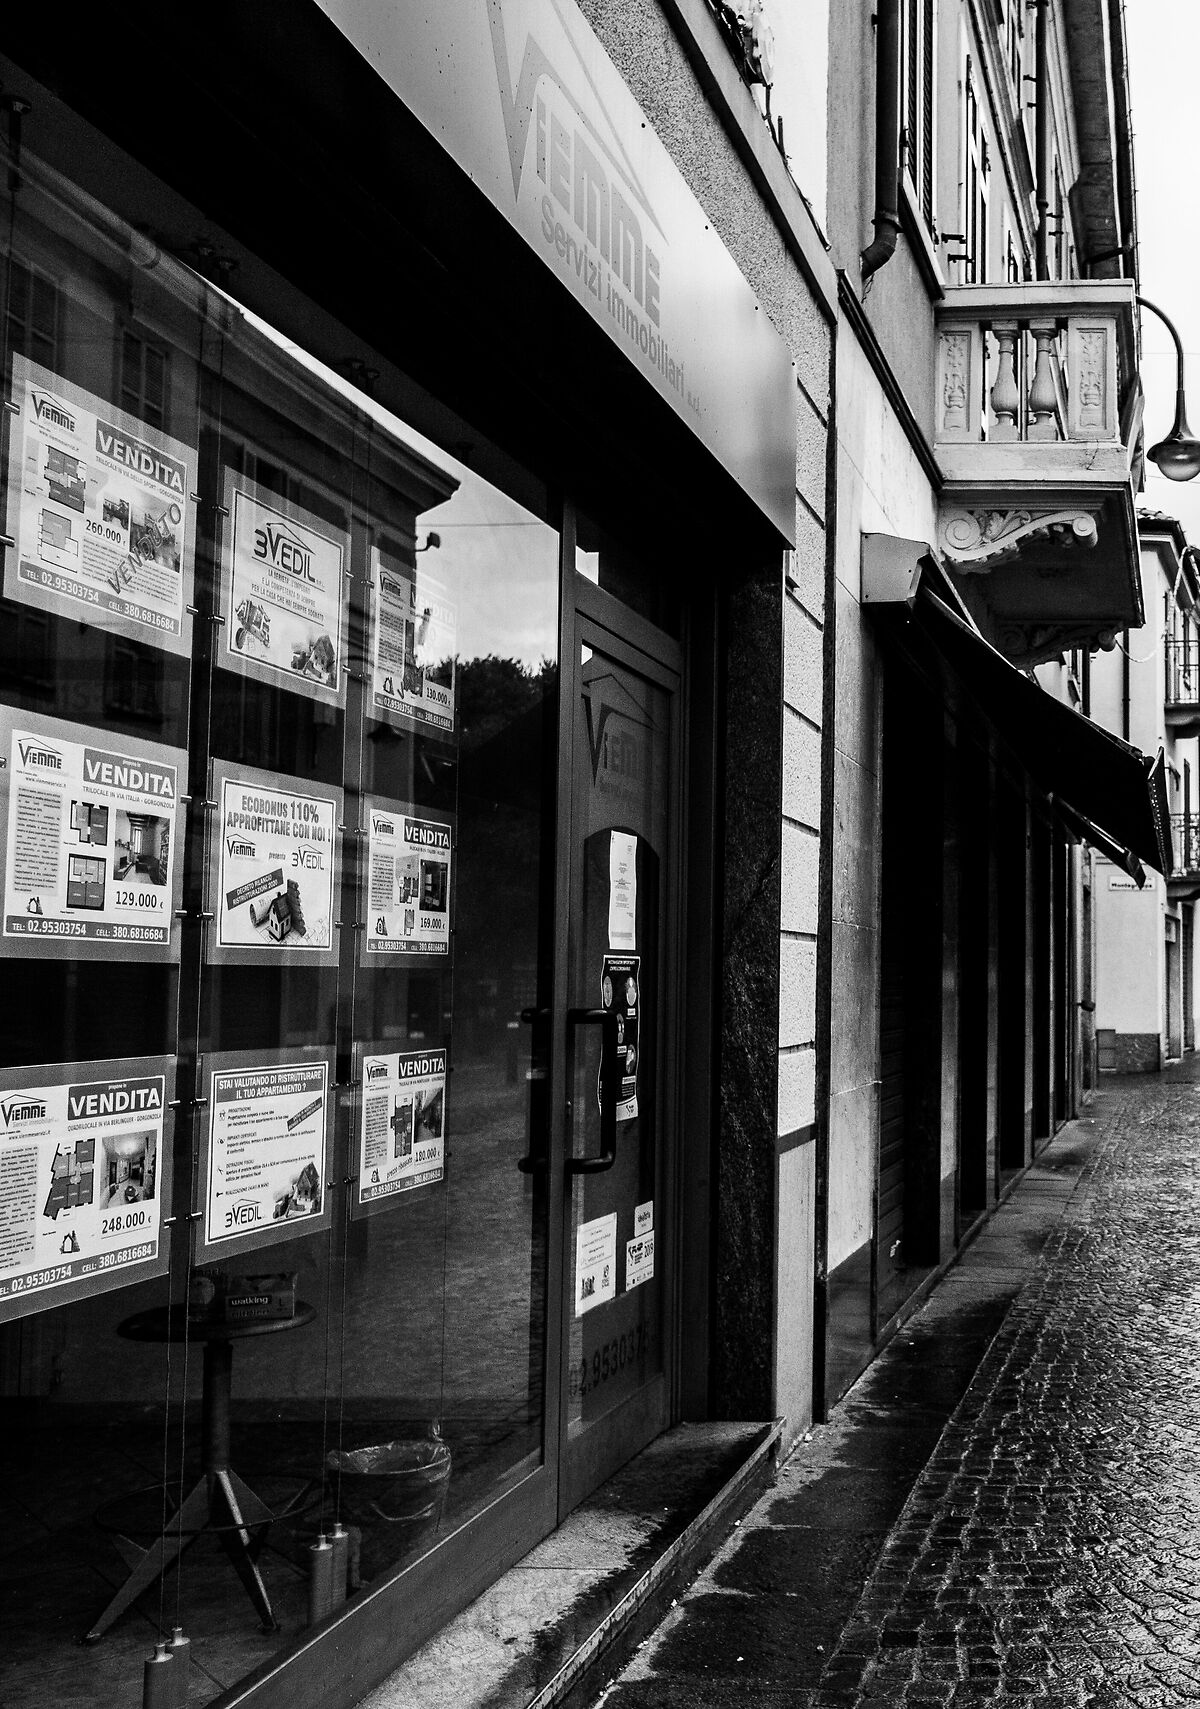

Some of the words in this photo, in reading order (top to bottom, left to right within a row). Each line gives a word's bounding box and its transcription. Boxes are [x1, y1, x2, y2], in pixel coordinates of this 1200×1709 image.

[541, 195, 602, 302] Servizi
[97, 429, 184, 494] VENDITA
[85, 519, 122, 544] 260.000
[107, 502, 182, 596] VENDUTO
[26, 569, 40, 581] TEL:
[41, 571, 99, 604] 02.95303754
[108, 601, 123, 613] CELL:
[124, 602, 175, 632] 380.6816684
[426, 687, 448, 705] 130.000
[85, 758, 174, 797] VENDITA
[82, 785, 109, 797] TRILOCALE
[109, 790, 116, 798] IN
[116, 791, 125, 800] VIA
[125, 794, 140, 803] ITALIA
[143, 798, 175, 809] GORGONZOLA
[241, 795, 288, 819] ECOBONUS
[290, 800, 320, 824] 110%
[226, 811, 291, 837] APPROFITTANE
[292, 822, 310, 840] CON
[311, 825, 326, 843] NOI
[405, 825, 449, 848] VENDITA
[115, 890, 157, 909] 129.000
[12, 922, 26, 932] TEL:
[27, 919, 87, 936] 02.95303754
[96, 928, 111, 937] CELL:
[112, 925, 164, 941] 380.6816684
[420, 917, 442, 930] 169.000
[399, 1057, 445, 1077] VENDITA
[219, 1079, 233, 1090] STAI
[234, 1075, 270, 1089] VALUTANDO
[270, 1074, 278, 1084] DI
[278, 1070, 322, 1084] RISTRUTTURARE
[236, 1090, 242, 1100] IL
[243, 1089, 256, 1098] TUO
[256, 1083, 302, 1097] APPARTAMENTO
[70, 1087, 161, 1117] VENDITA
[67, 1121, 98, 1132] QUADRILOCALE
[110, 1116, 134, 1126] BERLINGUER
[136, 1113, 161, 1122] GORGONZOLA
[415, 1147, 437, 1162] 180.000
[101, 1210, 146, 1235] 248.000
[0, 1286, 9, 1295] EL:
[11, 1265, 72, 1292] 02.95303754
[82, 1263, 97, 1273] CELL:
[98, 1244, 152, 1269] 380.6816684
[231, 1296, 269, 1306] walking
